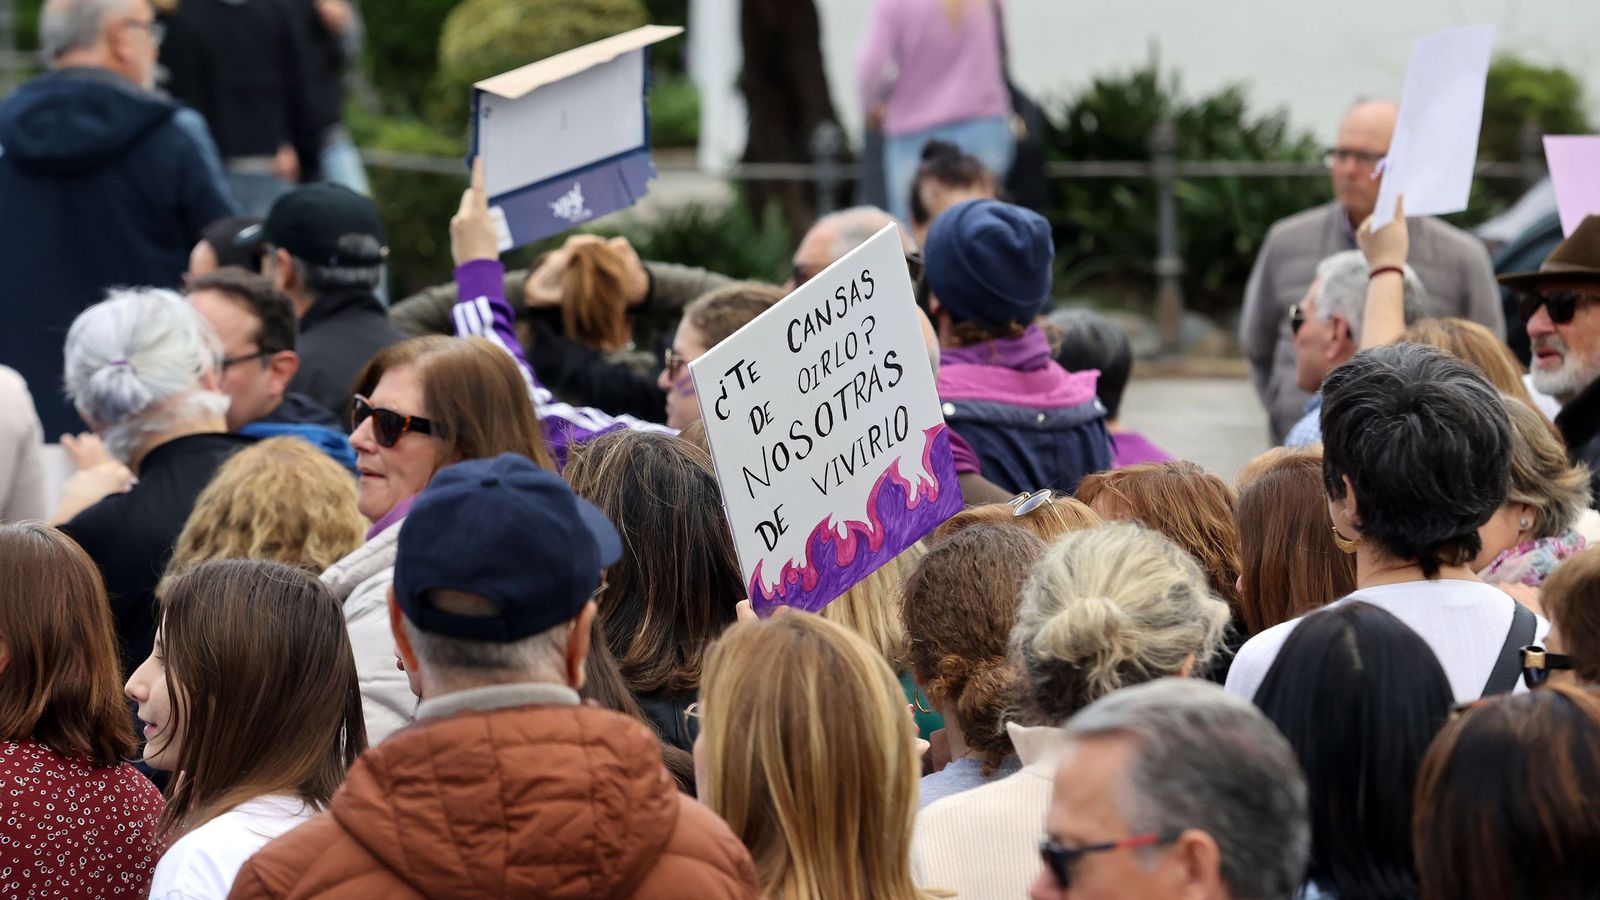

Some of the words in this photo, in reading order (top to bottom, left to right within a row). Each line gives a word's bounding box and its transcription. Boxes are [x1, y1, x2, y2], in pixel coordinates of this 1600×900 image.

[748, 401, 775, 435] DE
[798, 315, 876, 394] OIRLO?
[787, 269, 875, 353] CANSAS
[742, 350, 903, 499] NOSOTRAS
[754, 503, 790, 552] DE
[811, 404, 910, 495] VIVIRLO
